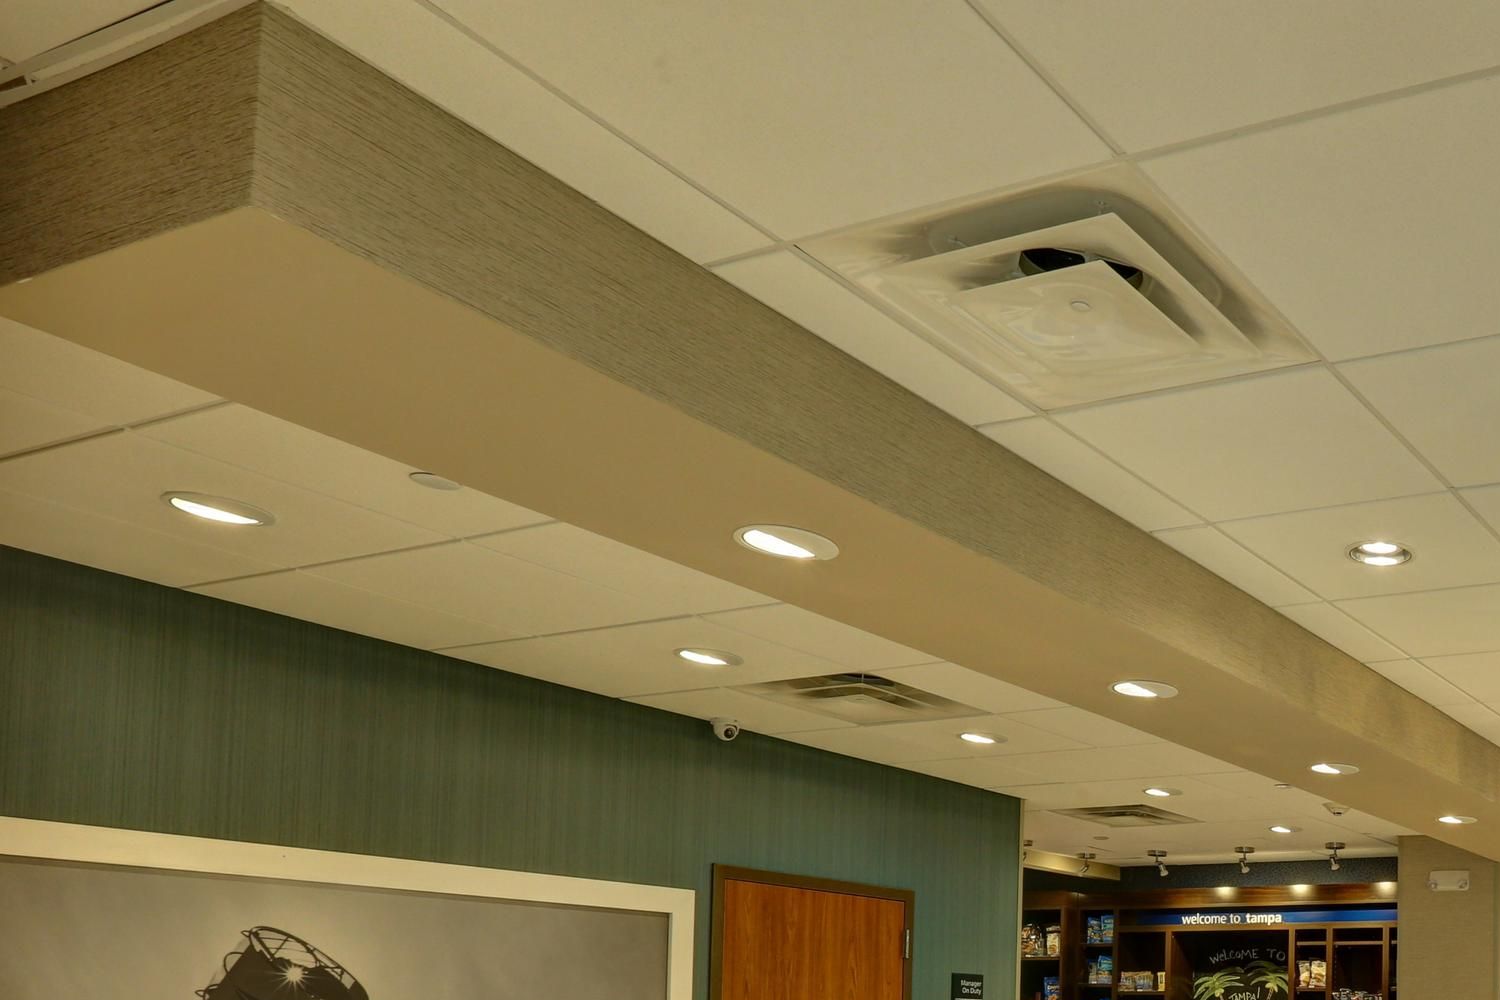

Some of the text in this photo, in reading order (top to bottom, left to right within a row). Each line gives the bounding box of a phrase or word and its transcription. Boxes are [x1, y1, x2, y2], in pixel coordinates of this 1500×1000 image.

[1181, 912, 1282, 925] welcome to tampa
[1266, 948, 1286, 961] TO
[960, 979, 982, 988] Manager
